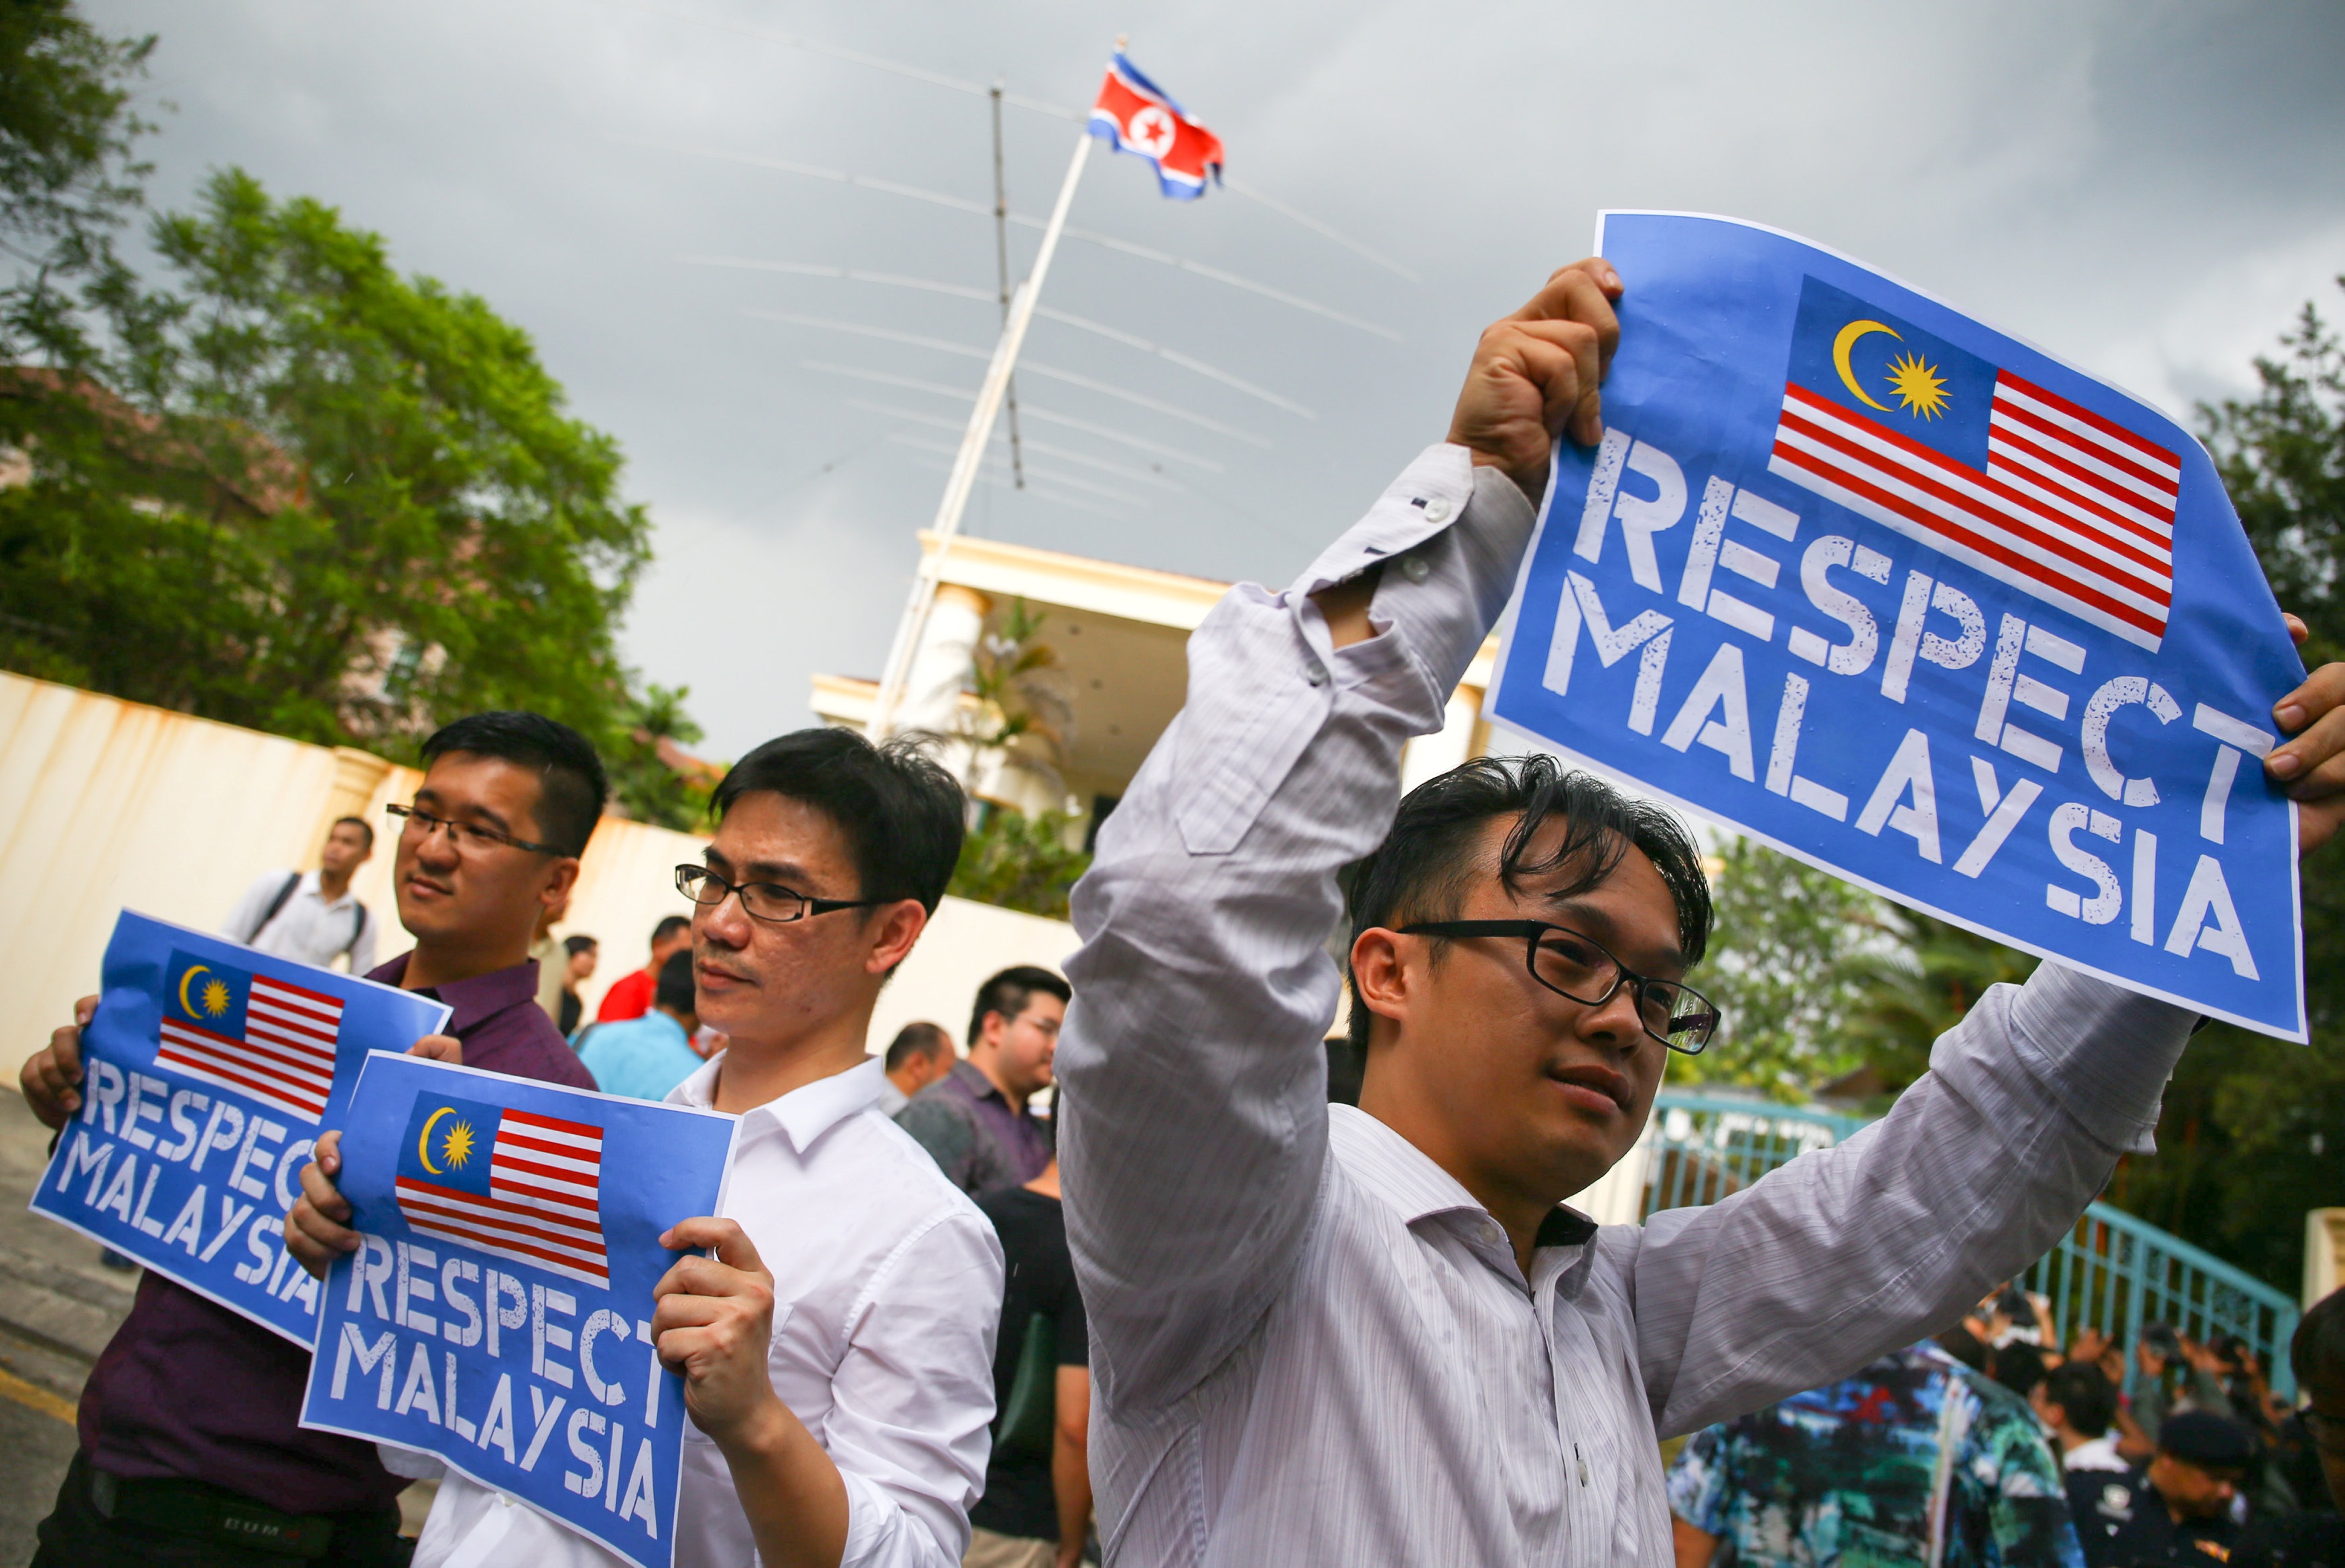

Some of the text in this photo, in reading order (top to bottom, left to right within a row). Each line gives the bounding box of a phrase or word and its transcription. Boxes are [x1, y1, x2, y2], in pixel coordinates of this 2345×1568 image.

[1572, 426, 2276, 845] RESPECT
[1542, 569, 2261, 981] MALAYSIA
[56, 1131, 320, 1316] MALAYSIA
[82, 1057, 318, 1212] RESPEC
[330, 1322, 658, 1541] MALAYSIA
[346, 1233, 663, 1429] RESPECT
